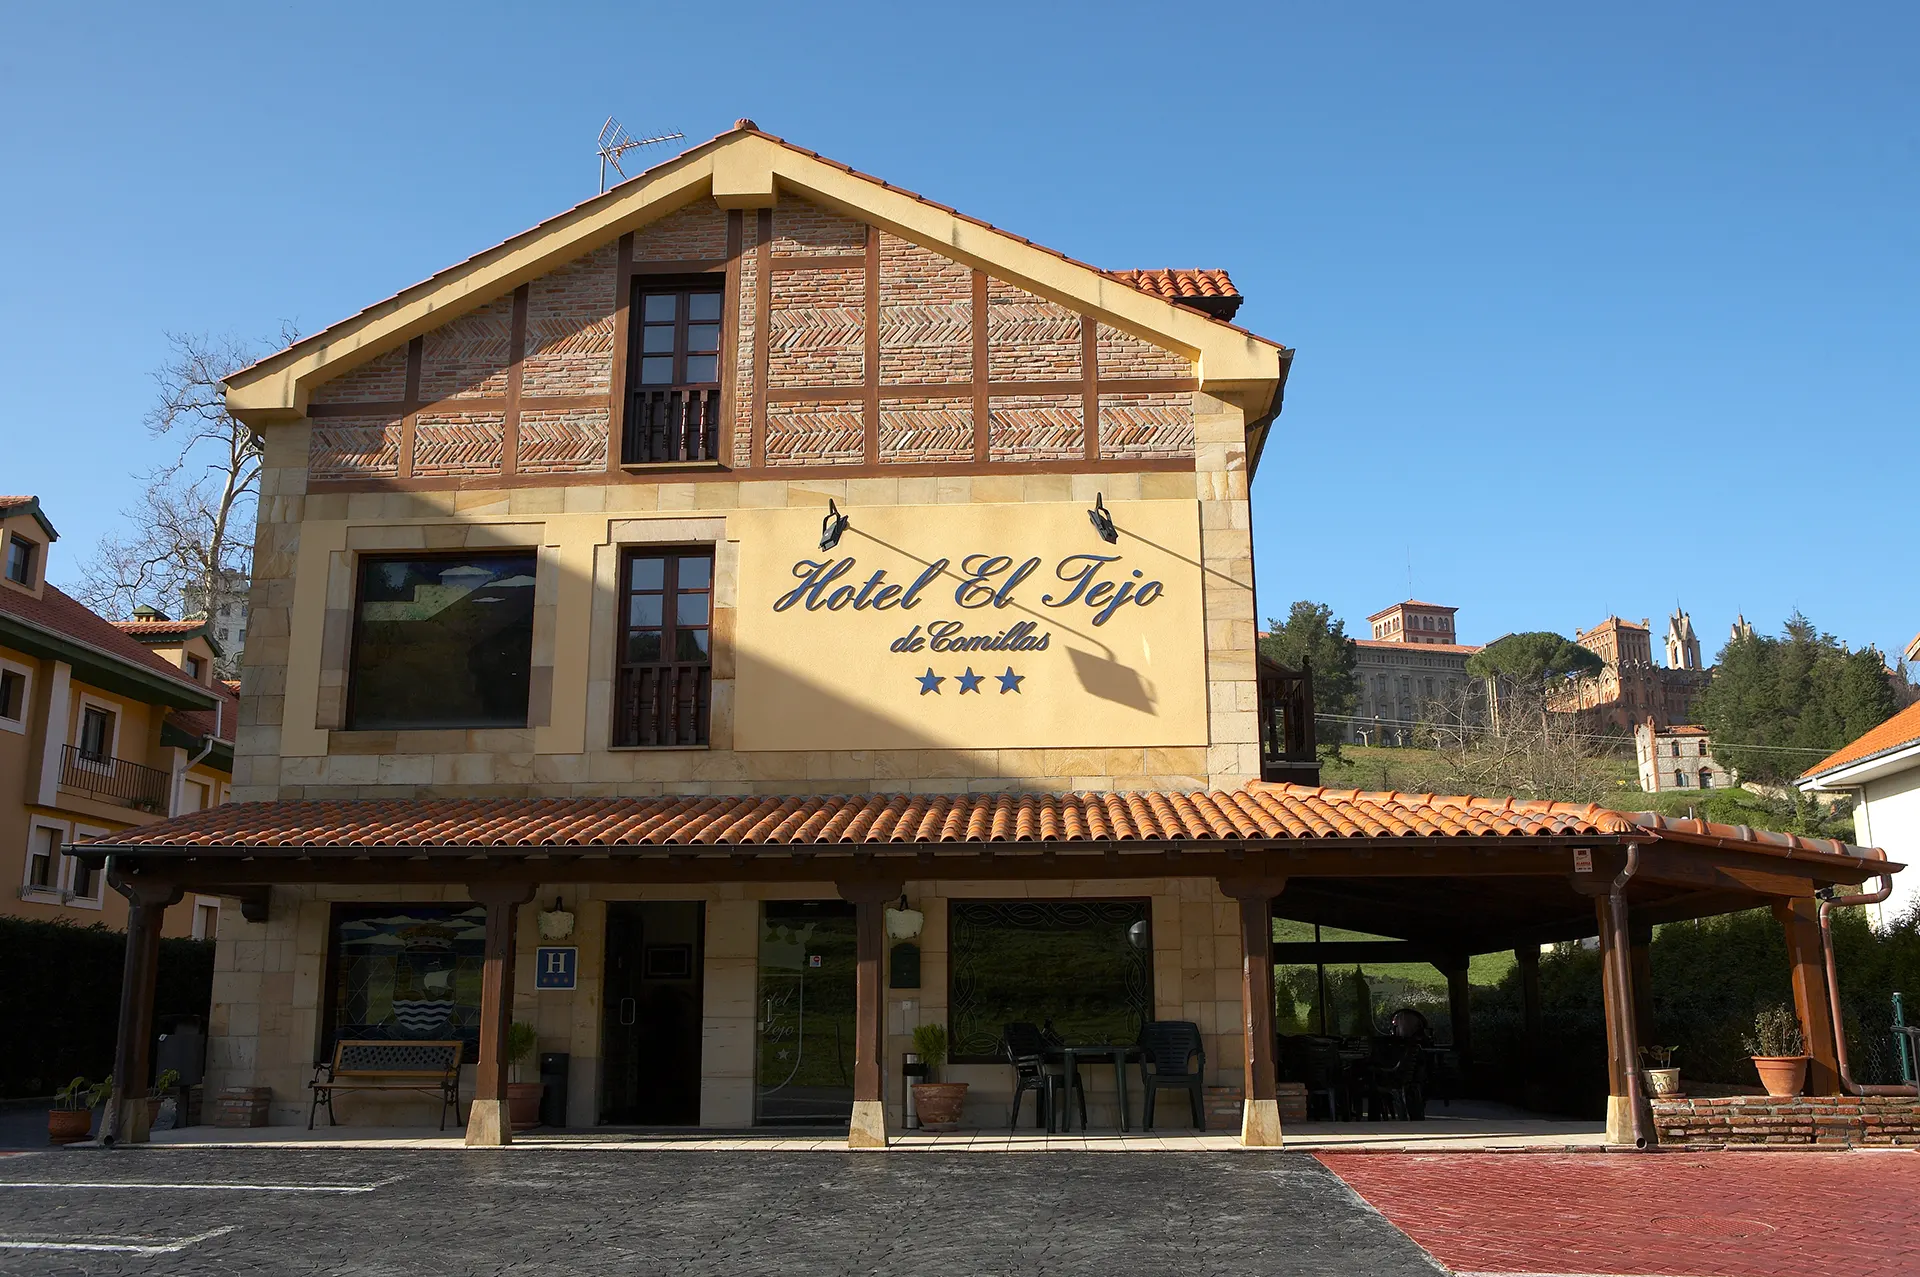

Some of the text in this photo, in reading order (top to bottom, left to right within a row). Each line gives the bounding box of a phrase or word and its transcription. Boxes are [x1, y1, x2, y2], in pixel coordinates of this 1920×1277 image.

[773, 554, 1164, 627] Hotel El Tejo
[889, 620, 1052, 653] de Comillas
[545, 952, 568, 974] H
